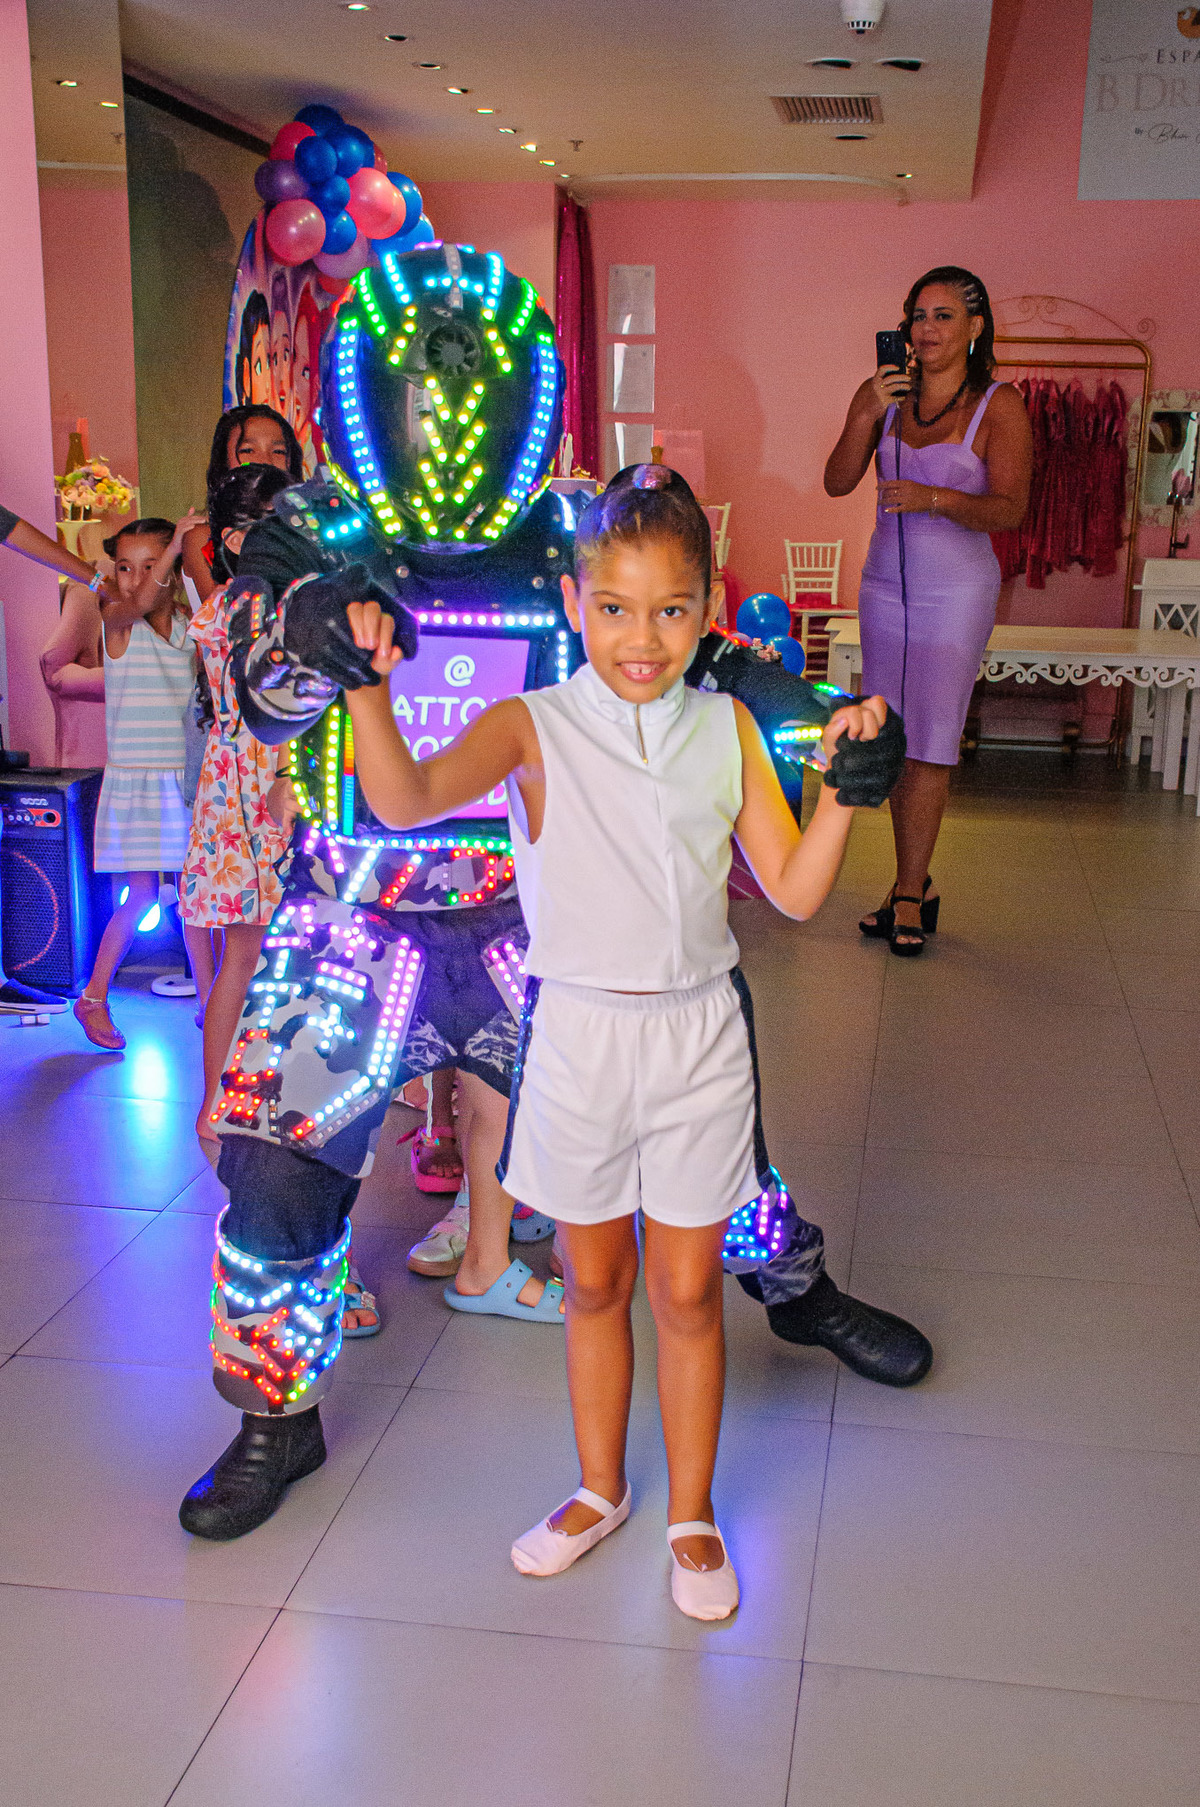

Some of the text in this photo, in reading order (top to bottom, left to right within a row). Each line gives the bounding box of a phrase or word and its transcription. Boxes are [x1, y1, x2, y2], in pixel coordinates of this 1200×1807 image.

[1096, 73, 1200, 112] B DR
[444, 654, 476, 688] @
[393, 694, 498, 727] ATTO
